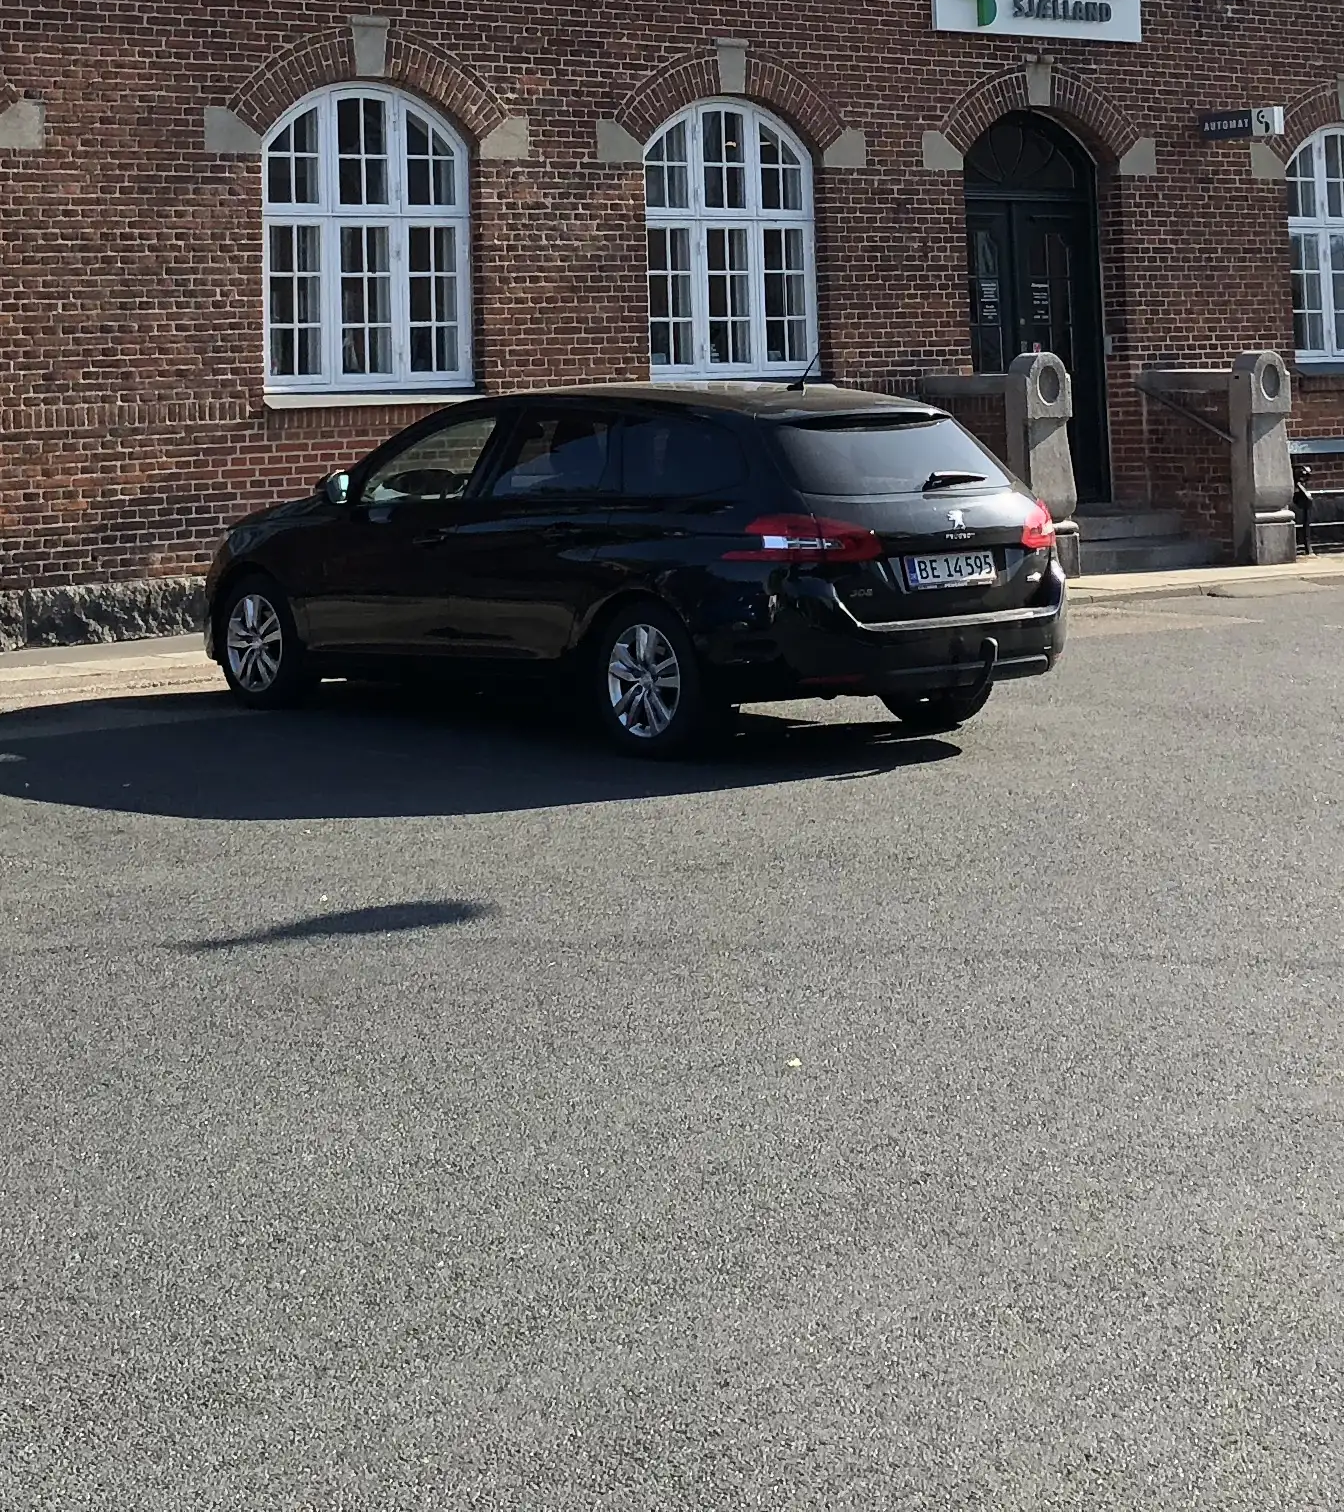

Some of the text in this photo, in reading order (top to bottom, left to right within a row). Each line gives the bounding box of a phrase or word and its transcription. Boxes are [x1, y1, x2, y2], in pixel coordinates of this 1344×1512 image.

[1203, 118, 1250, 132] AUTOMAT
[917, 559, 941, 580] BE
[943, 557, 963, 578] 14
[965, 554, 993, 576] 595
